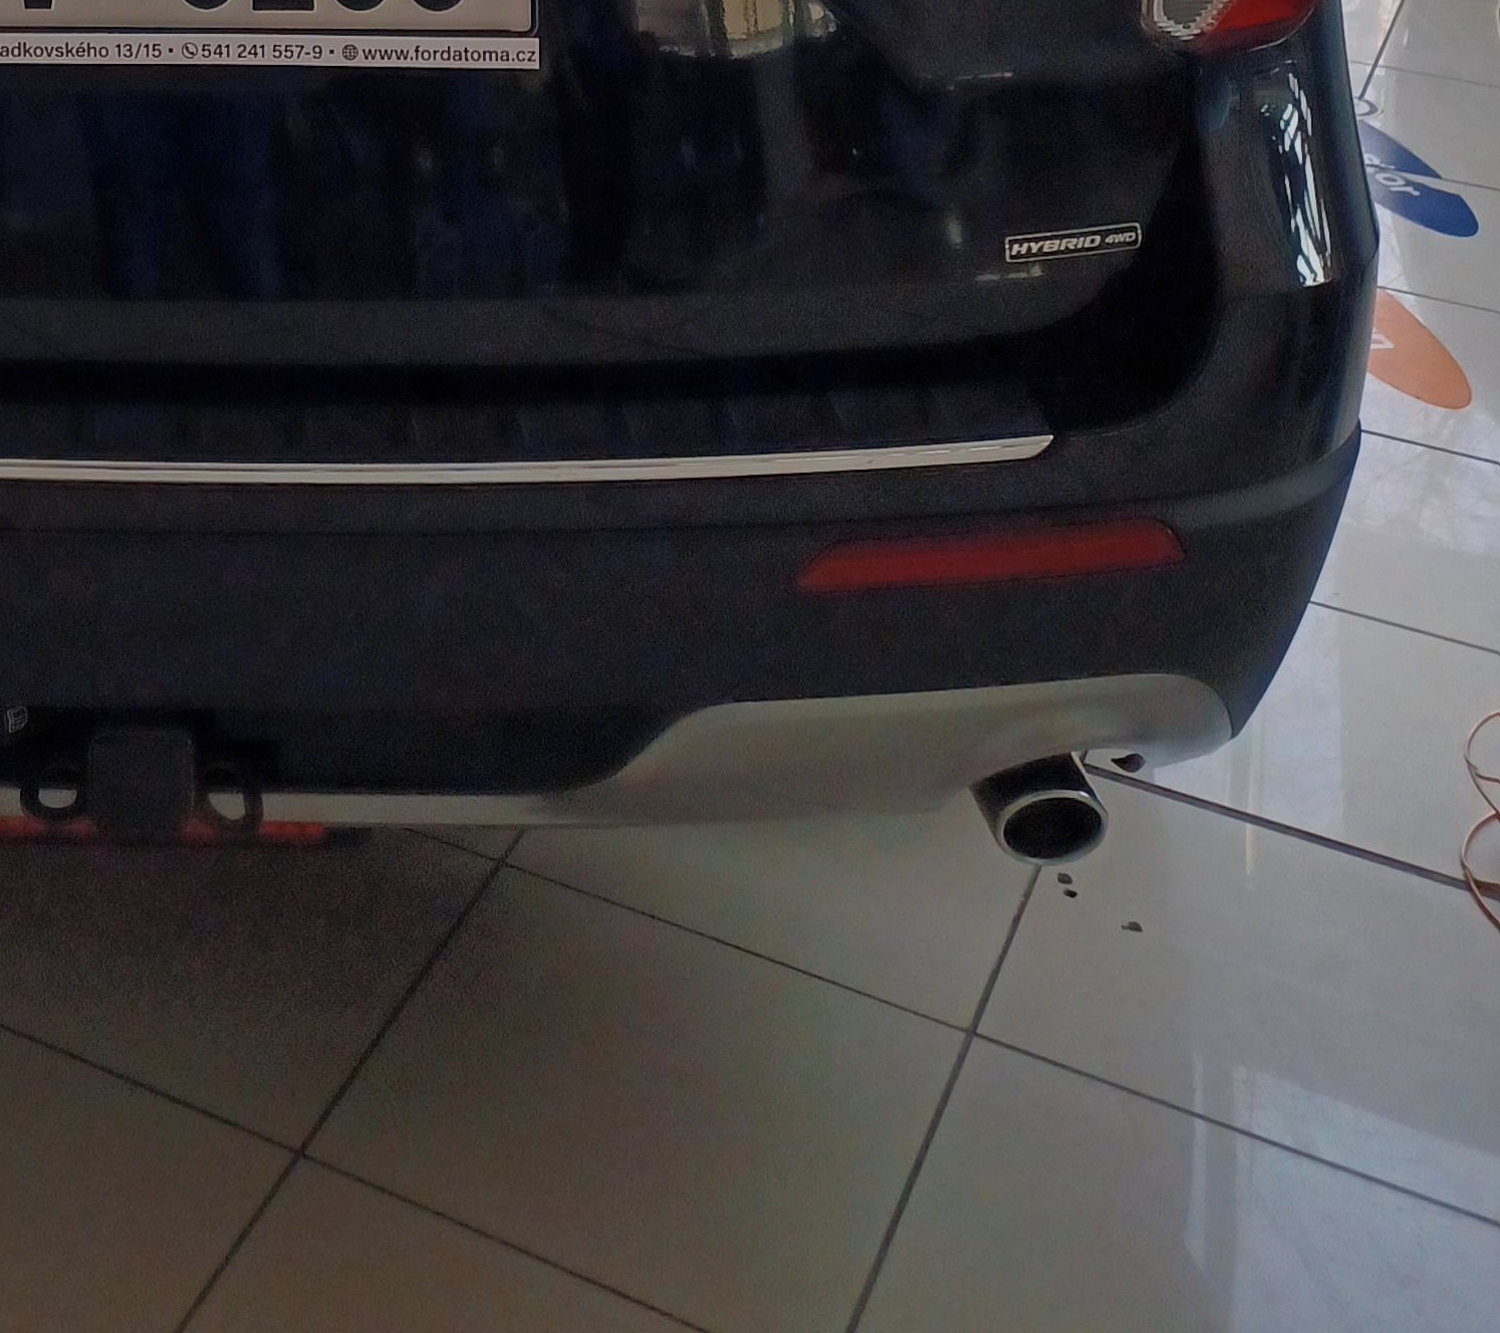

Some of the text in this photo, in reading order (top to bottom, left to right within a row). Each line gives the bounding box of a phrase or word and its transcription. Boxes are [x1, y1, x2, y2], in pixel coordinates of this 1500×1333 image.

[115, 42, 162, 60] 13/15
[201, 43, 231, 60] 541
[236, 43, 266, 60] 241
[272, 43, 323, 61] 557-9
[362, 44, 537, 64] www.fordatoma.cz
[1011, 232, 1137, 256] HYBRID 4WD
